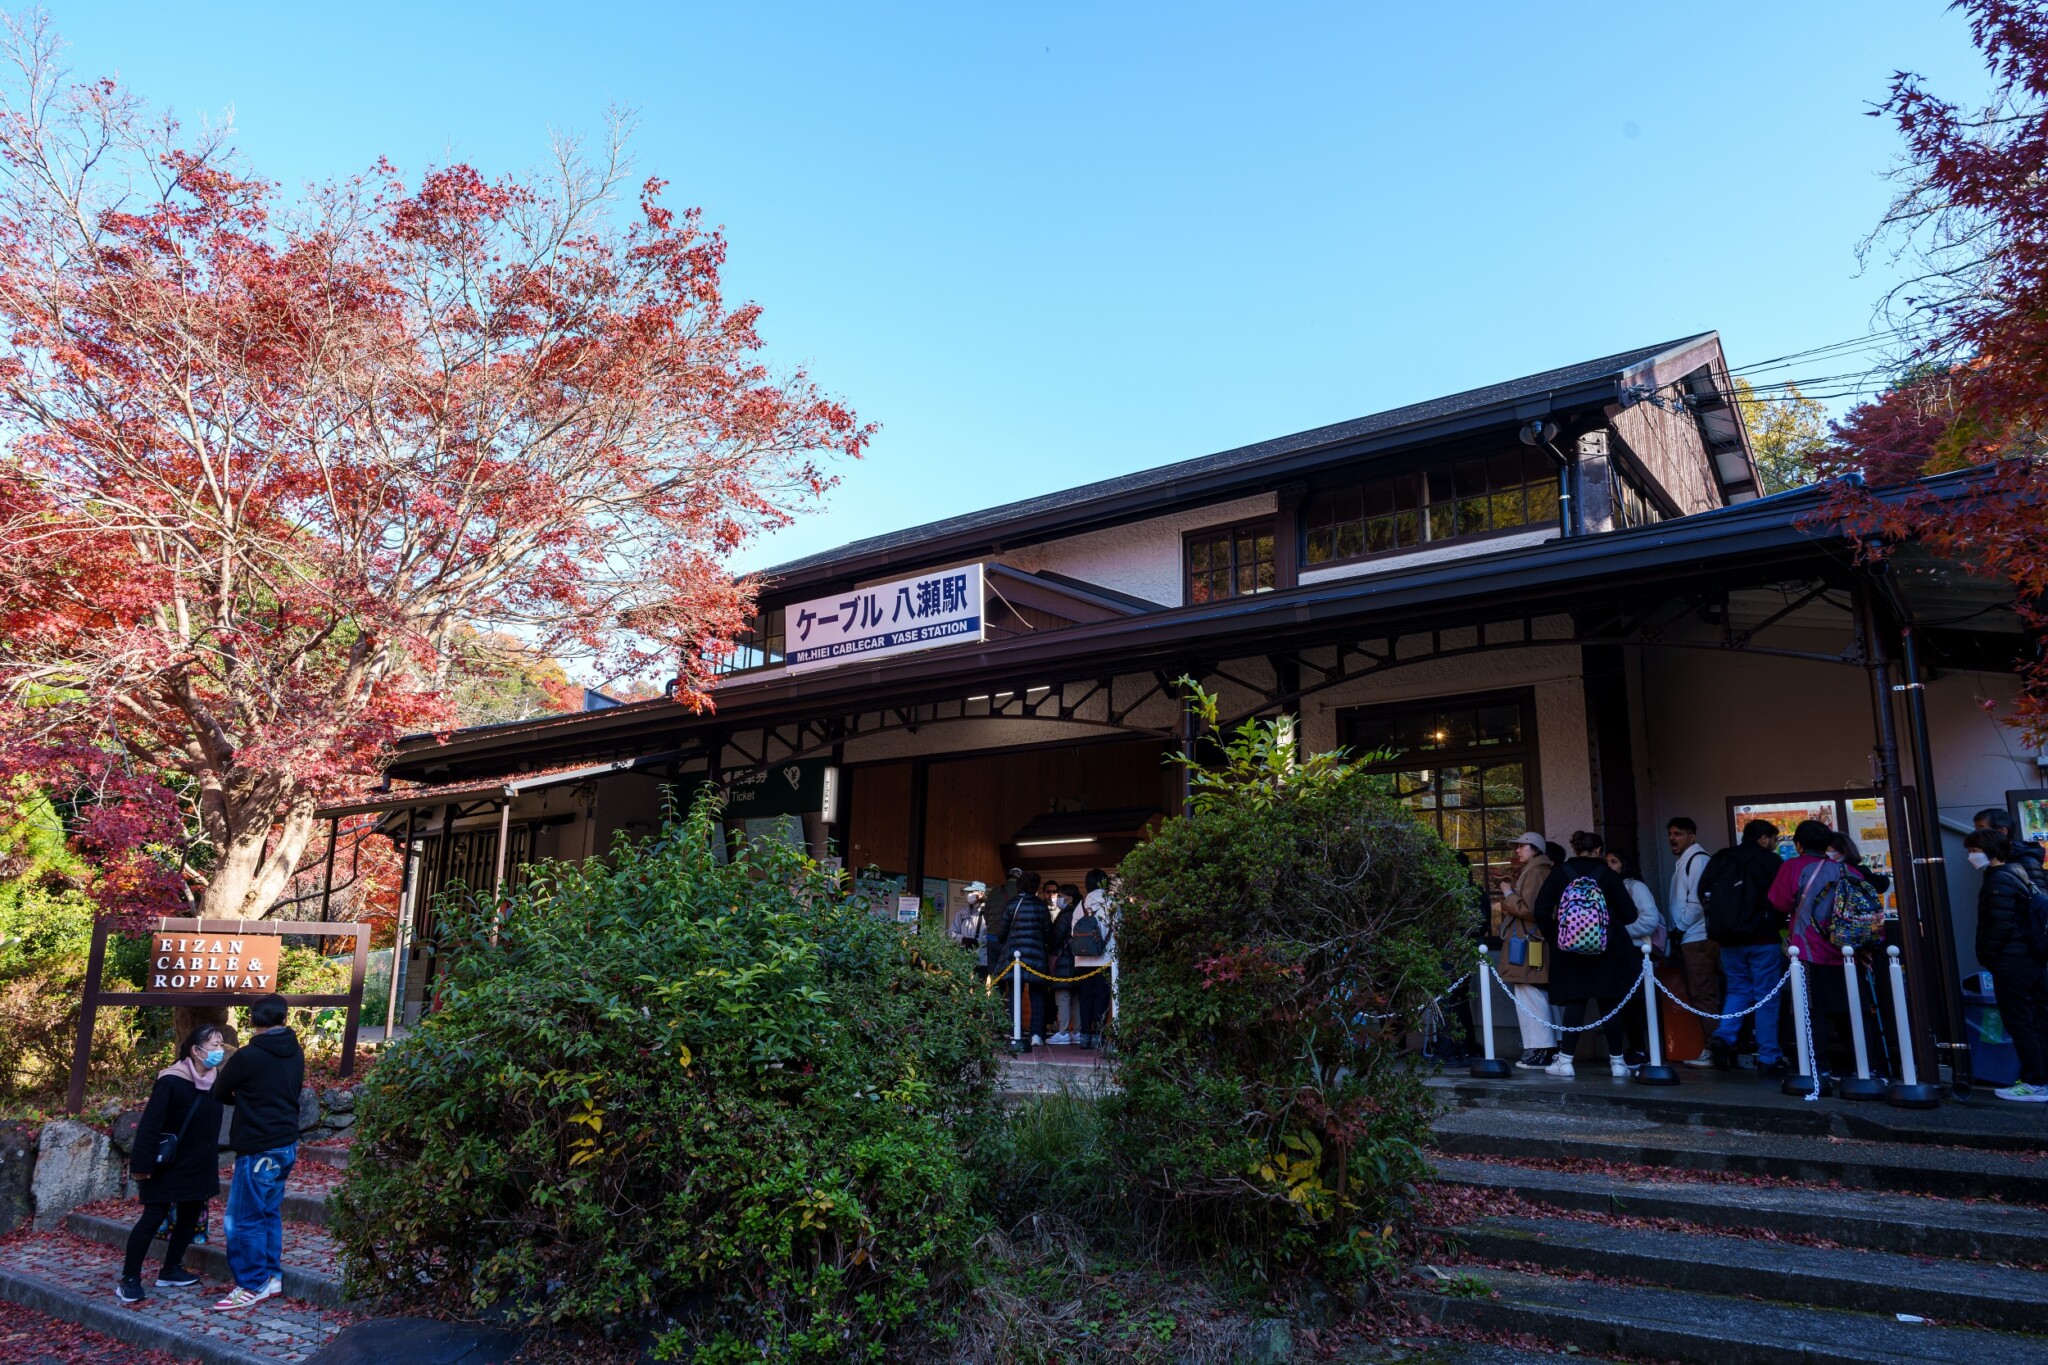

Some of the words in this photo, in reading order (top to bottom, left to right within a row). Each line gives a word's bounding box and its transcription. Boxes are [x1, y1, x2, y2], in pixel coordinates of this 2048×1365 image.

[796, 594, 883, 642] ケーブル
[892, 573, 967, 623] 八瀬駅
[796, 646, 830, 663] Mt.HIEI
[832, 637, 885, 656] CABLECAR
[891, 630, 918, 644] YASE
[921, 620, 968, 639] STATION
[731, 790, 755, 802] Ticket
[160, 939, 244, 953] EIZAN
[157, 956, 239, 971] CABLE
[247, 958, 263, 971] &
[154, 975, 270, 988] ROPEWAY
